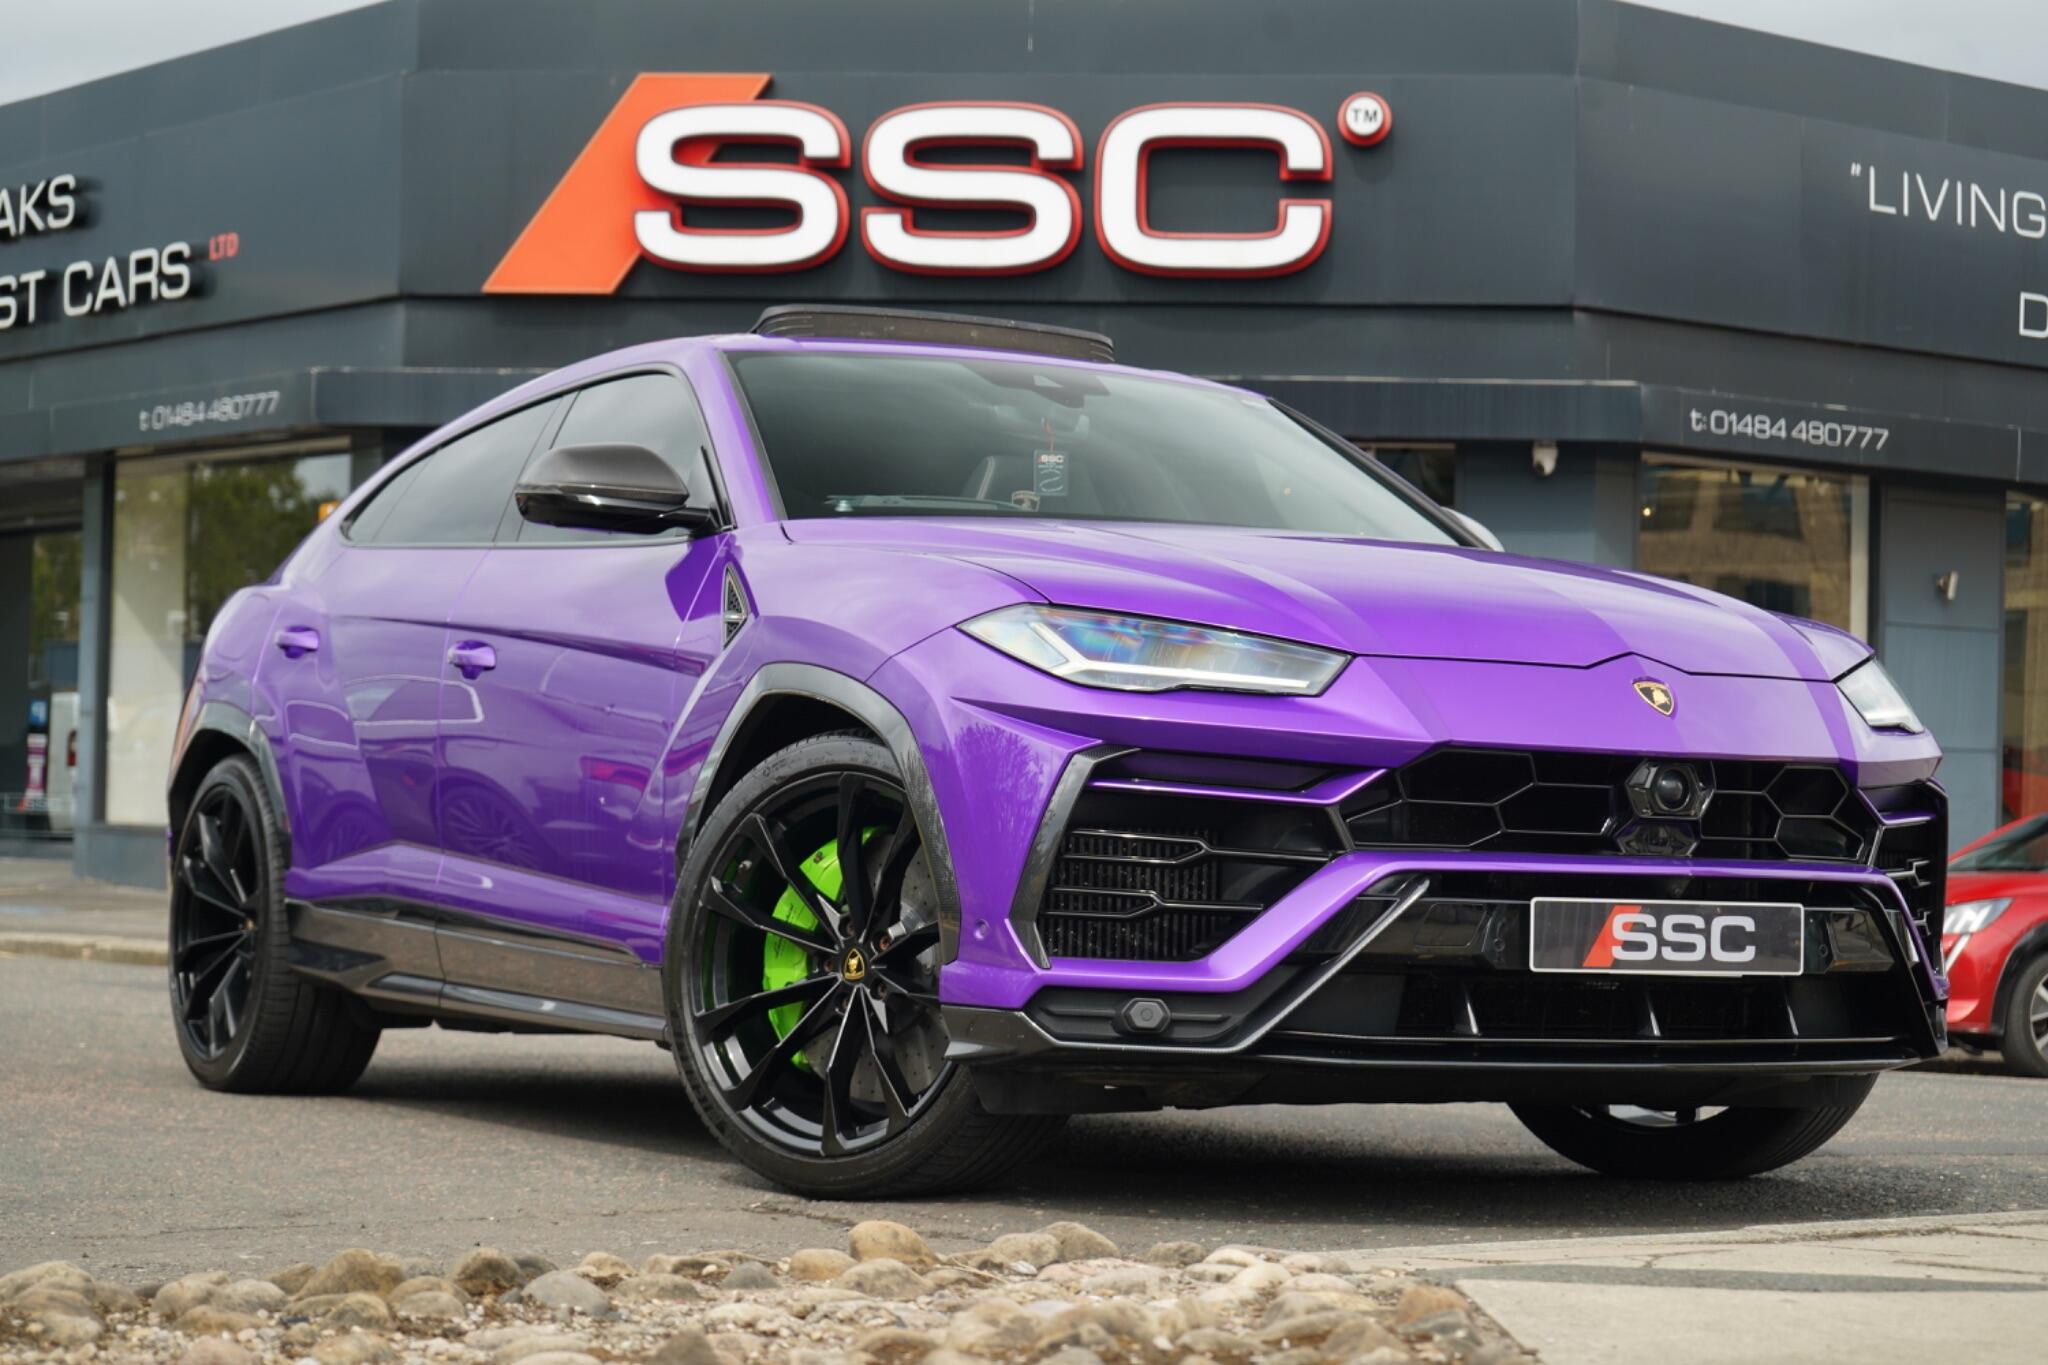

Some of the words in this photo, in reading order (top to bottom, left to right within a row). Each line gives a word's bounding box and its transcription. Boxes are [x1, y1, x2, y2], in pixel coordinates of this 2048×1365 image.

[1352, 108, 1378, 123] TM
[634, 101, 1333, 276] SSC
[1850, 162, 2047, 239] "LIVING
[63, 241, 191, 317] CARS
[208, 232, 239, 261] LTD
[1791, 420, 1889, 451] 480777
[1611, 913, 1756, 962] SSC
